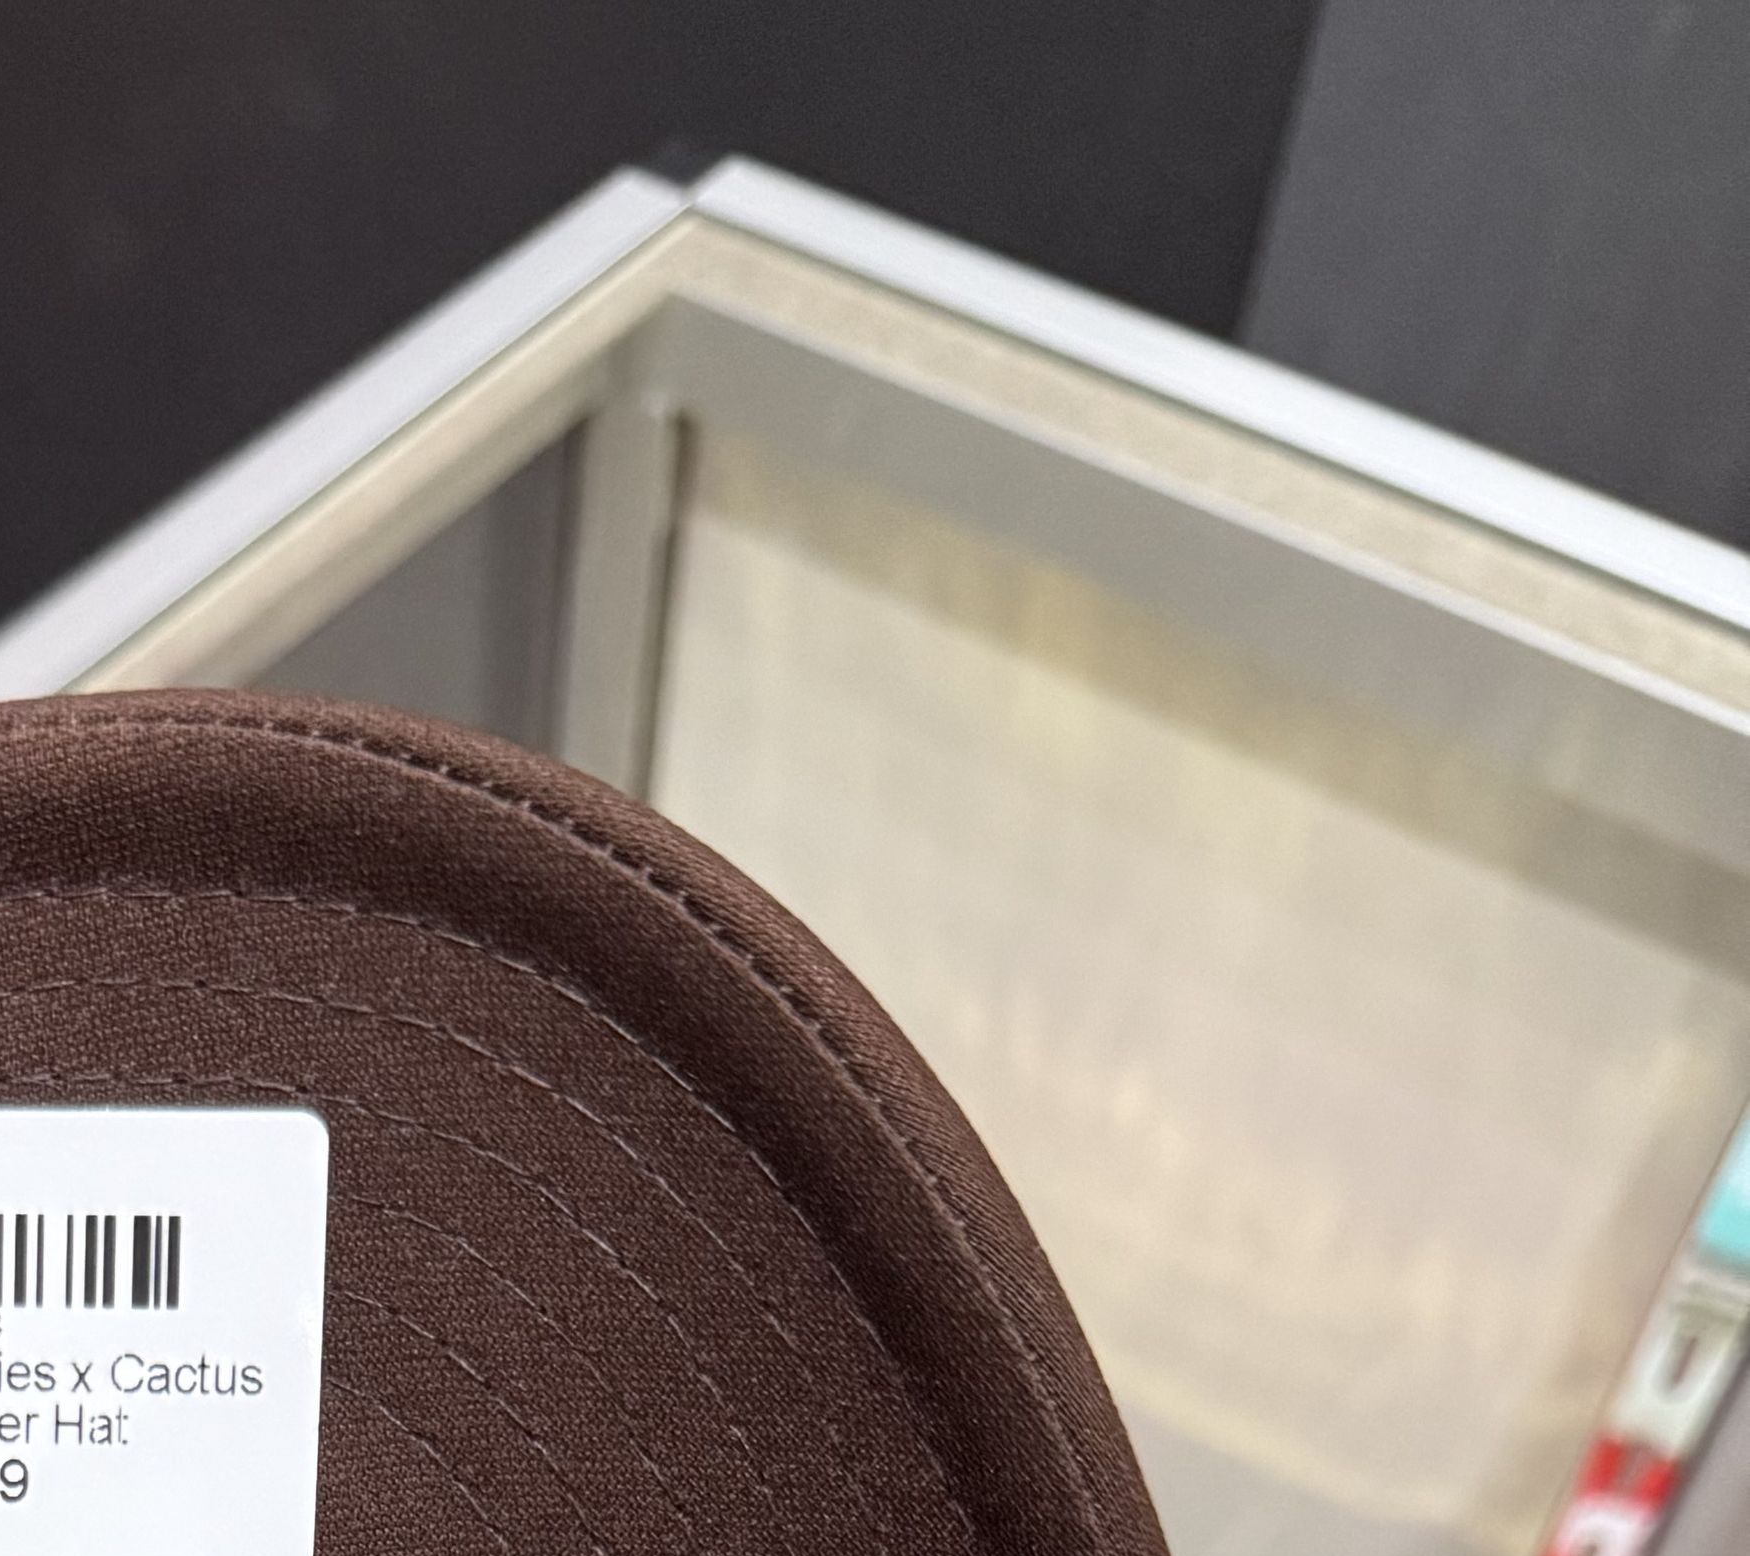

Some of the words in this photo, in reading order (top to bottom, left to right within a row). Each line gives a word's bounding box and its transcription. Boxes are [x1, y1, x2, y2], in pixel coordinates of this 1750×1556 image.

[71, 1361, 94, 1394] x
[110, 1352, 264, 1396] Cactus
[54, 1403, 130, 1446] Hat
